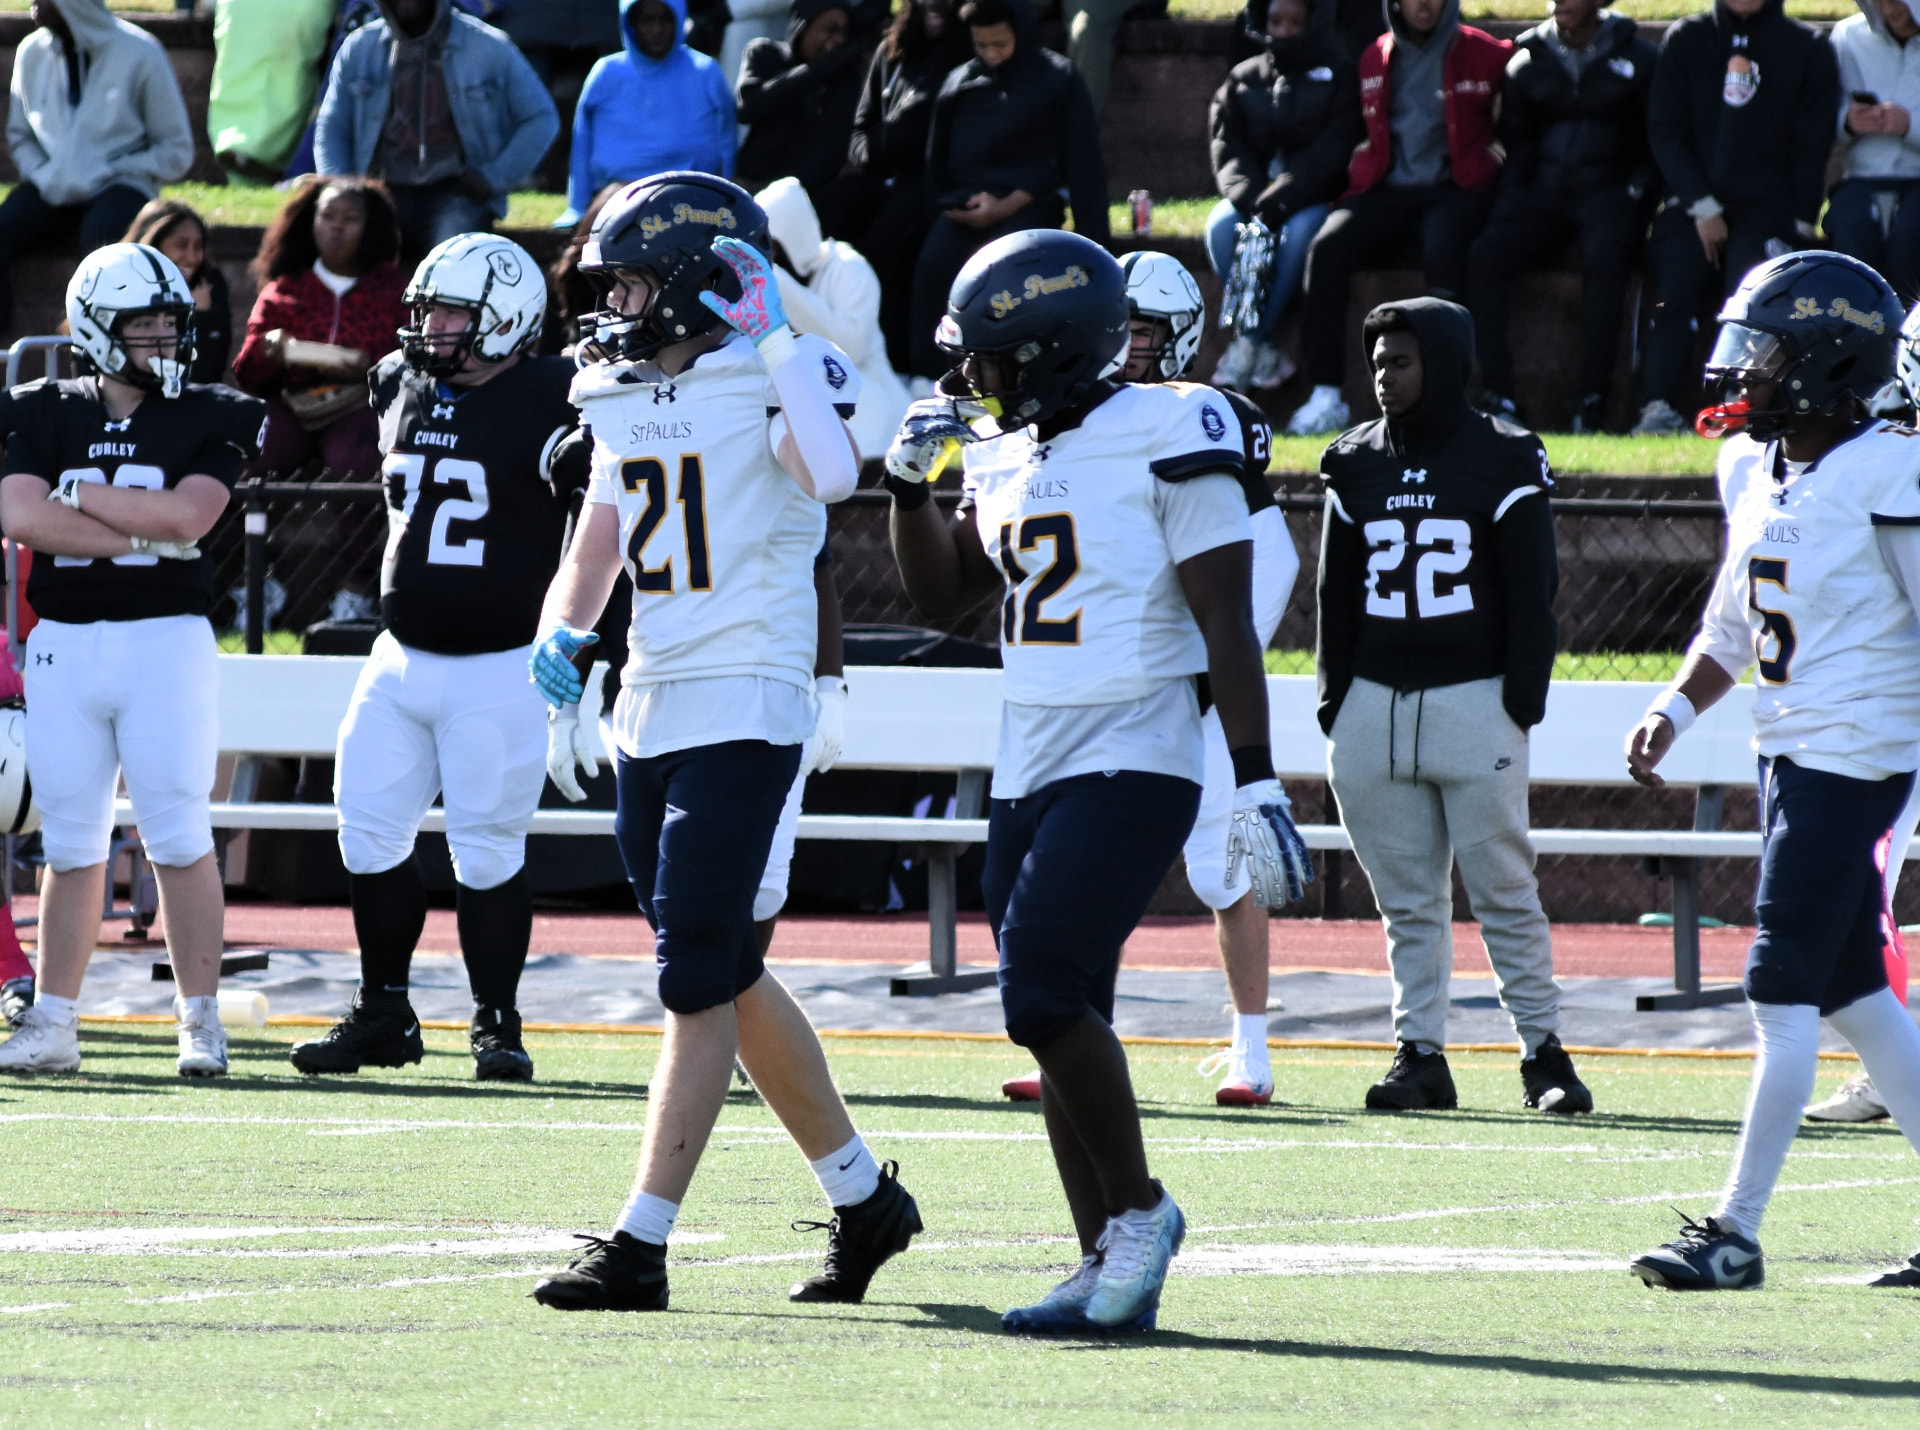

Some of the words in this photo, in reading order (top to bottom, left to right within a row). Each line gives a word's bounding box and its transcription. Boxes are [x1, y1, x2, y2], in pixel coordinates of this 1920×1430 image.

[673, 203, 737, 229] Paul's
[1024, 265, 1089, 300] Paul's
[1827, 297, 1886, 335] Paul's
[88, 443, 136, 459] CURLEY
[413, 430, 459, 449] CURLEY
[382, 452, 490, 568] 72
[1386, 494, 1436, 511] CURLEY
[620, 452, 713, 595] 21
[1000, 511, 1083, 647] 12
[1363, 517, 1475, 620] 22
[1748, 554, 1799, 687] 5
